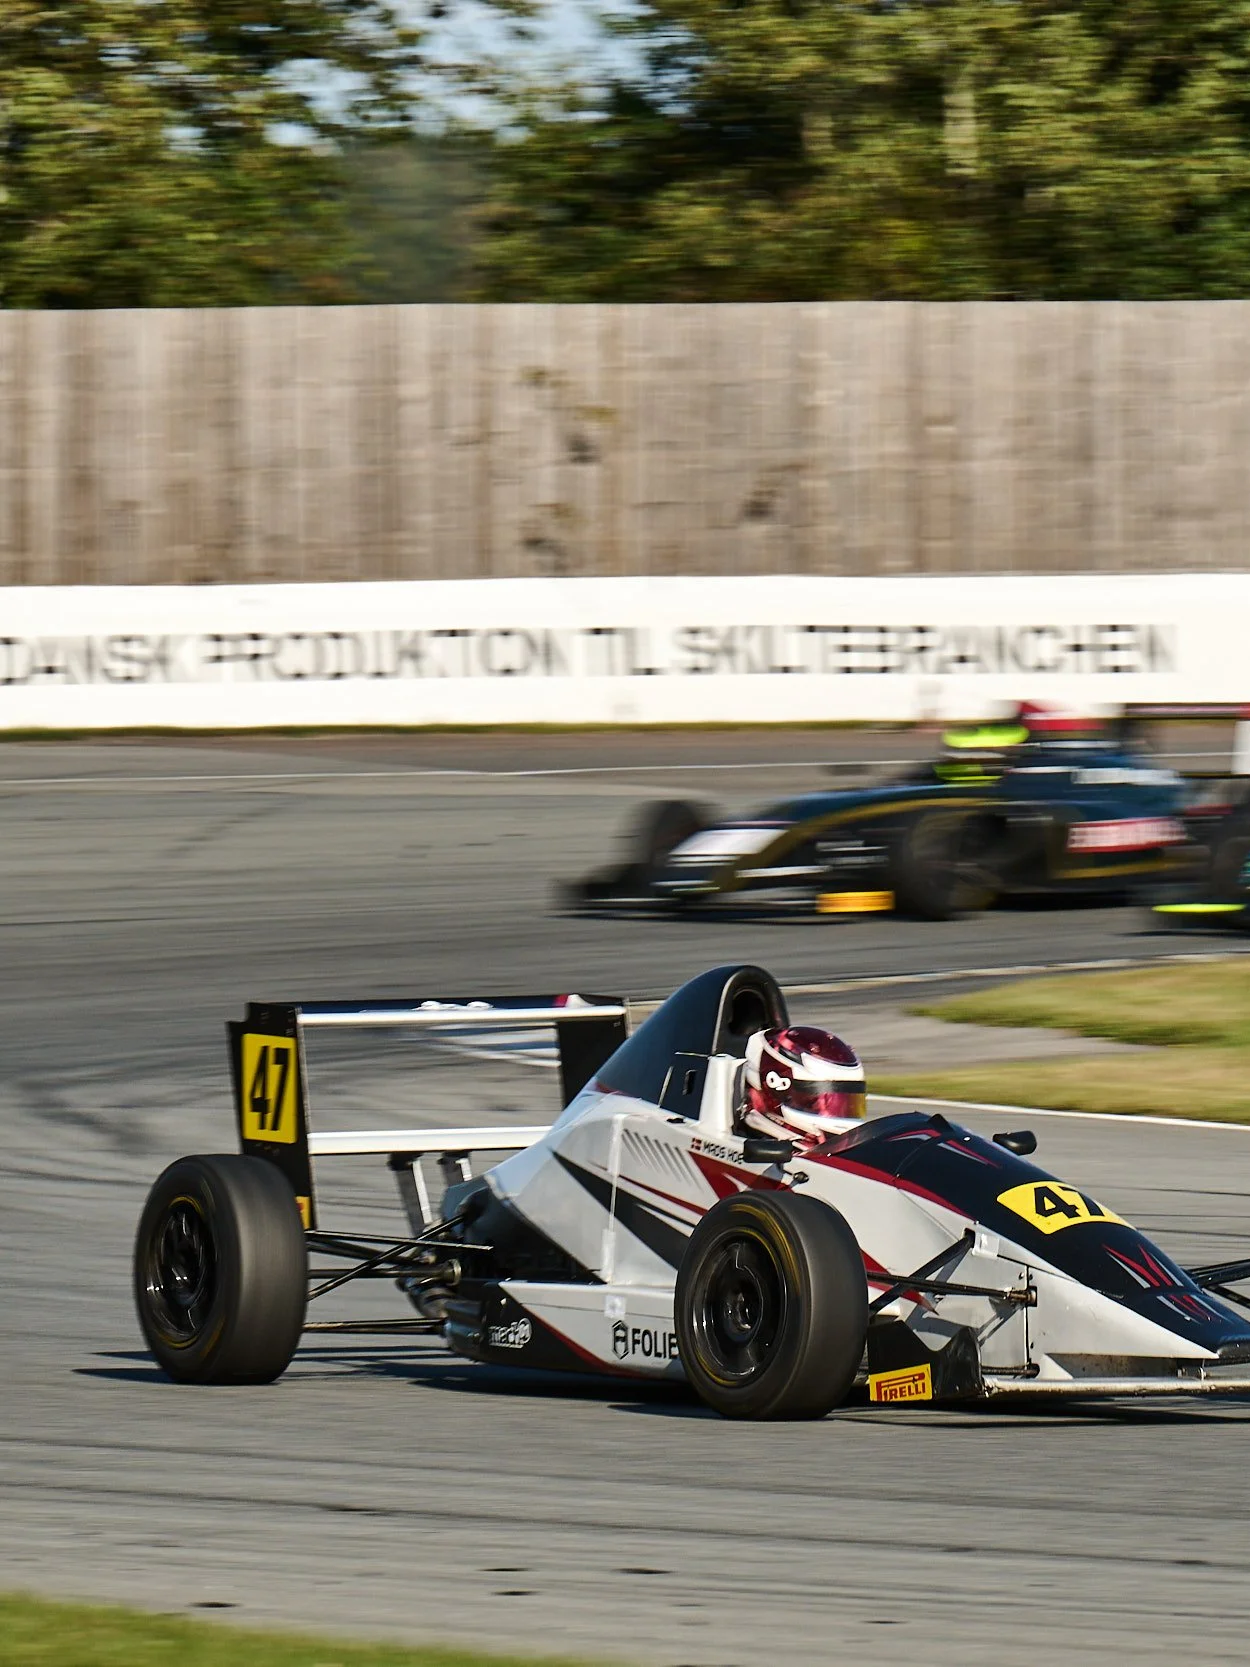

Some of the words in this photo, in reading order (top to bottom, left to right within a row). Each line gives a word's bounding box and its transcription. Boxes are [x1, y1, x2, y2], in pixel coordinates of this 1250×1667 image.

[0, 634, 190, 685] DANSK
[200, 628, 573, 682] PRODUKTION
[249, 1045, 290, 1131] 47
[1034, 1185, 1105, 1219] 47
[876, 1372, 926, 1401] PIRELLI
